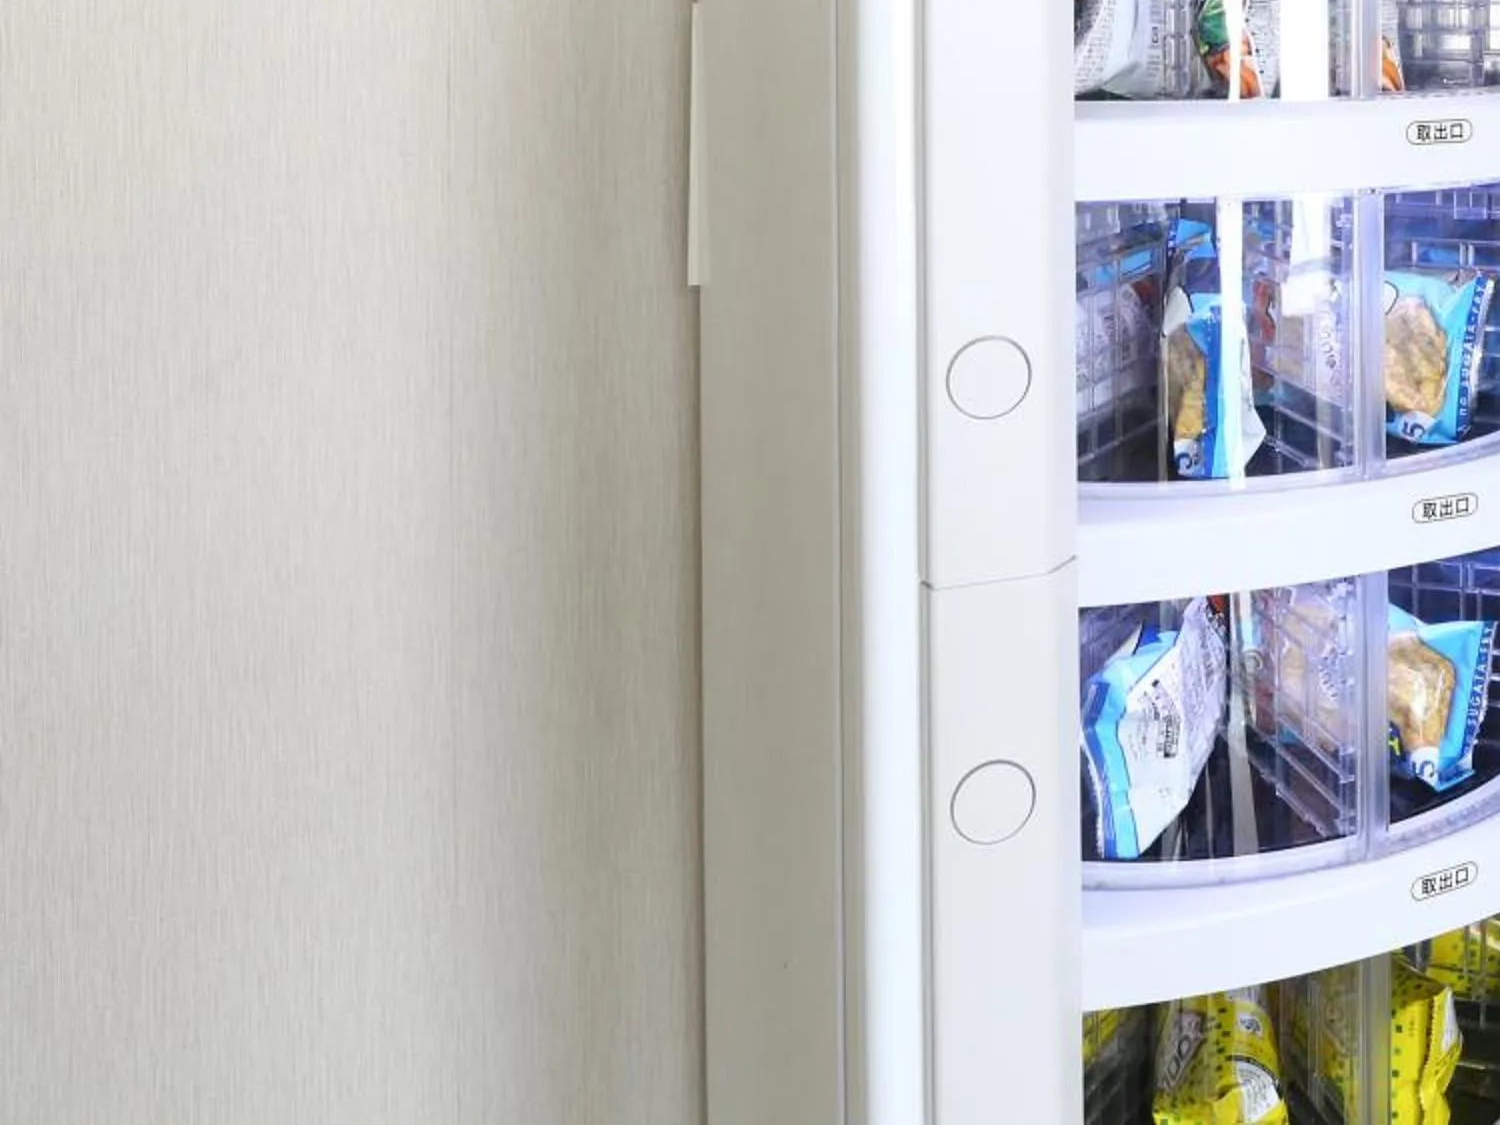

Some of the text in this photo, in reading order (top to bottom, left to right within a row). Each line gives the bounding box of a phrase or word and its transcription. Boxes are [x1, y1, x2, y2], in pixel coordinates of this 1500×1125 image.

[1416, 120, 1464, 142] 取出口
[1421, 495, 1470, 520] 取出口
[1420, 867, 1470, 896] 取出口
